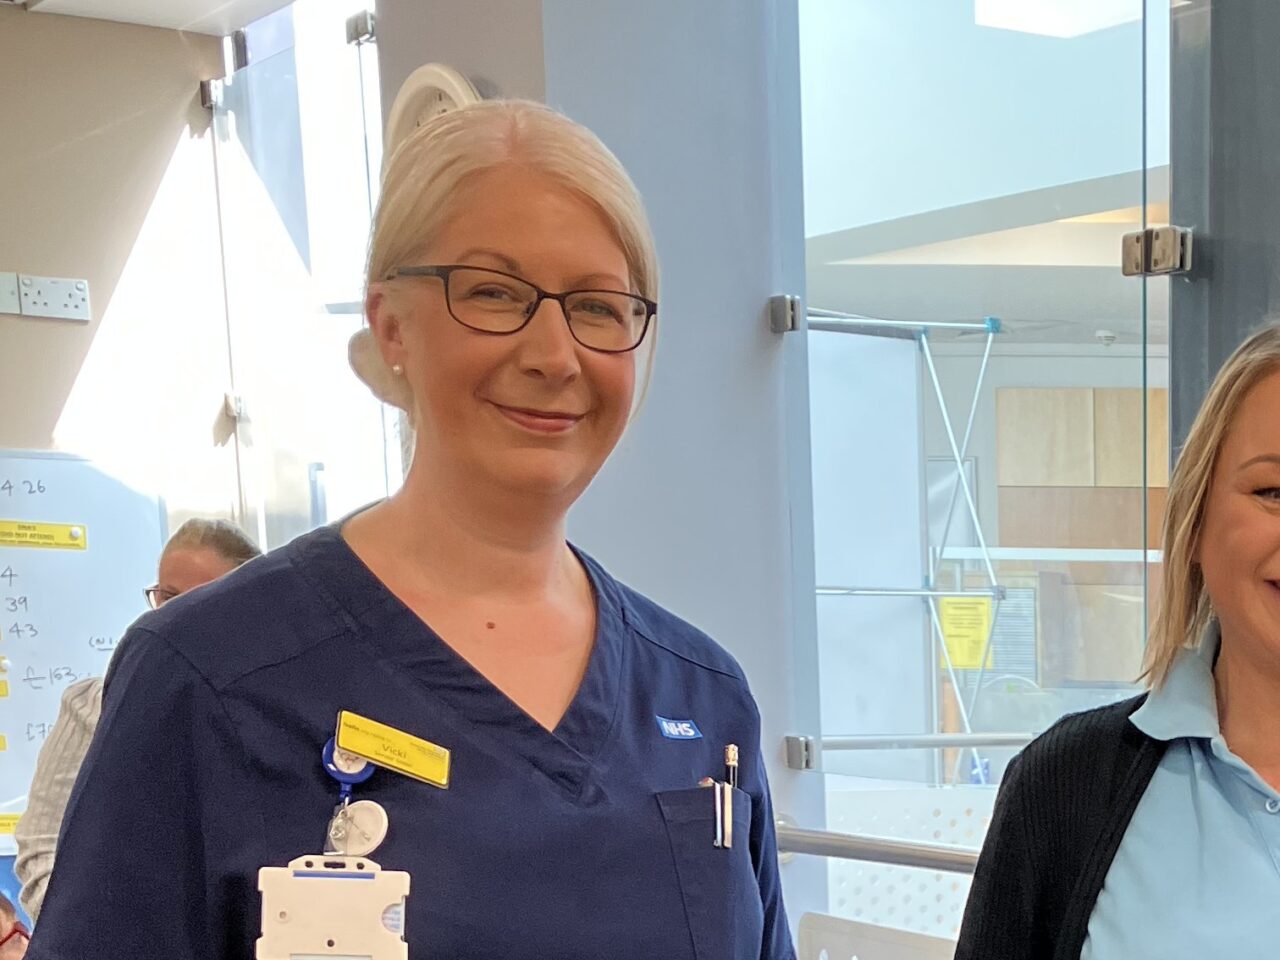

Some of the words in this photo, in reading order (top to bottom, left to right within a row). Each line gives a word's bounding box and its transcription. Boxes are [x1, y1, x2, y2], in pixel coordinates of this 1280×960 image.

[22, 479, 46, 494] 26
[5, 596, 28, 612] 39
[9, 622, 38, 638] 43
[662, 720, 695, 736] NHS
